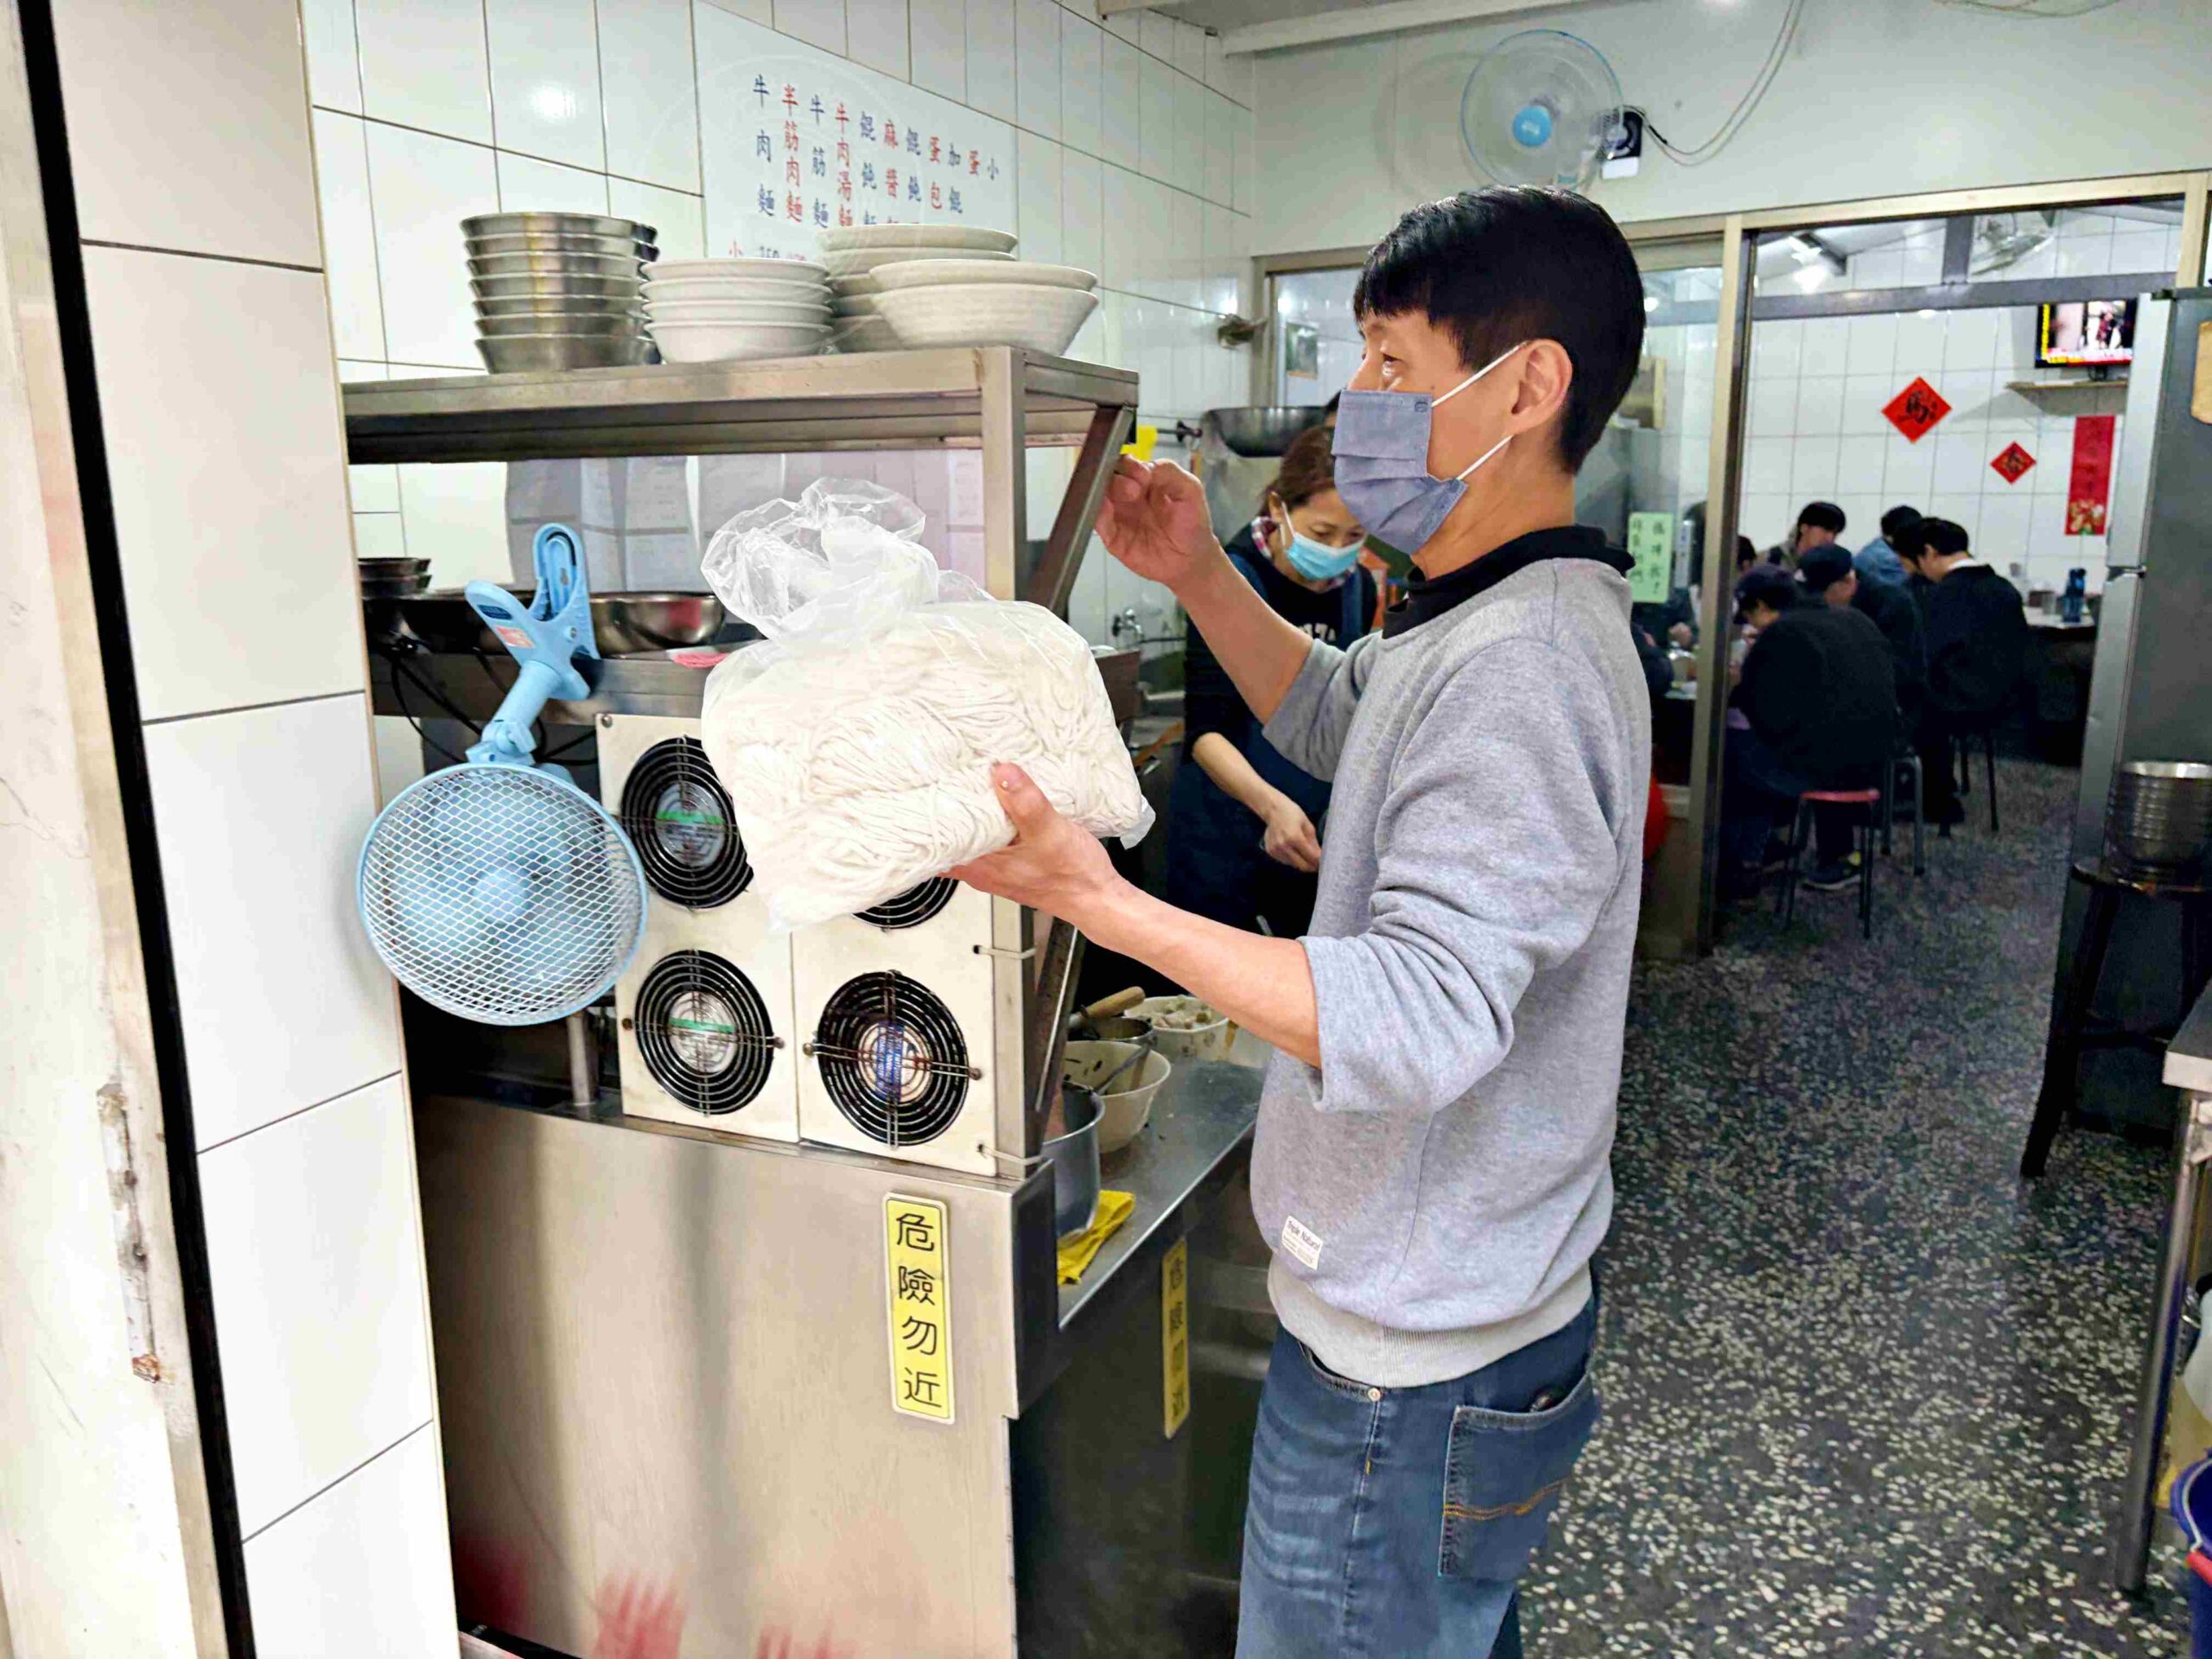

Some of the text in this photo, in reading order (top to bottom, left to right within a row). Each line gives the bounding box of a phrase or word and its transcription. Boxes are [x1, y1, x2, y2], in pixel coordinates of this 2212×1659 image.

[884, 119, 899, 225] 麻醬
[896, 1212, 943, 1408] 危險勿近
